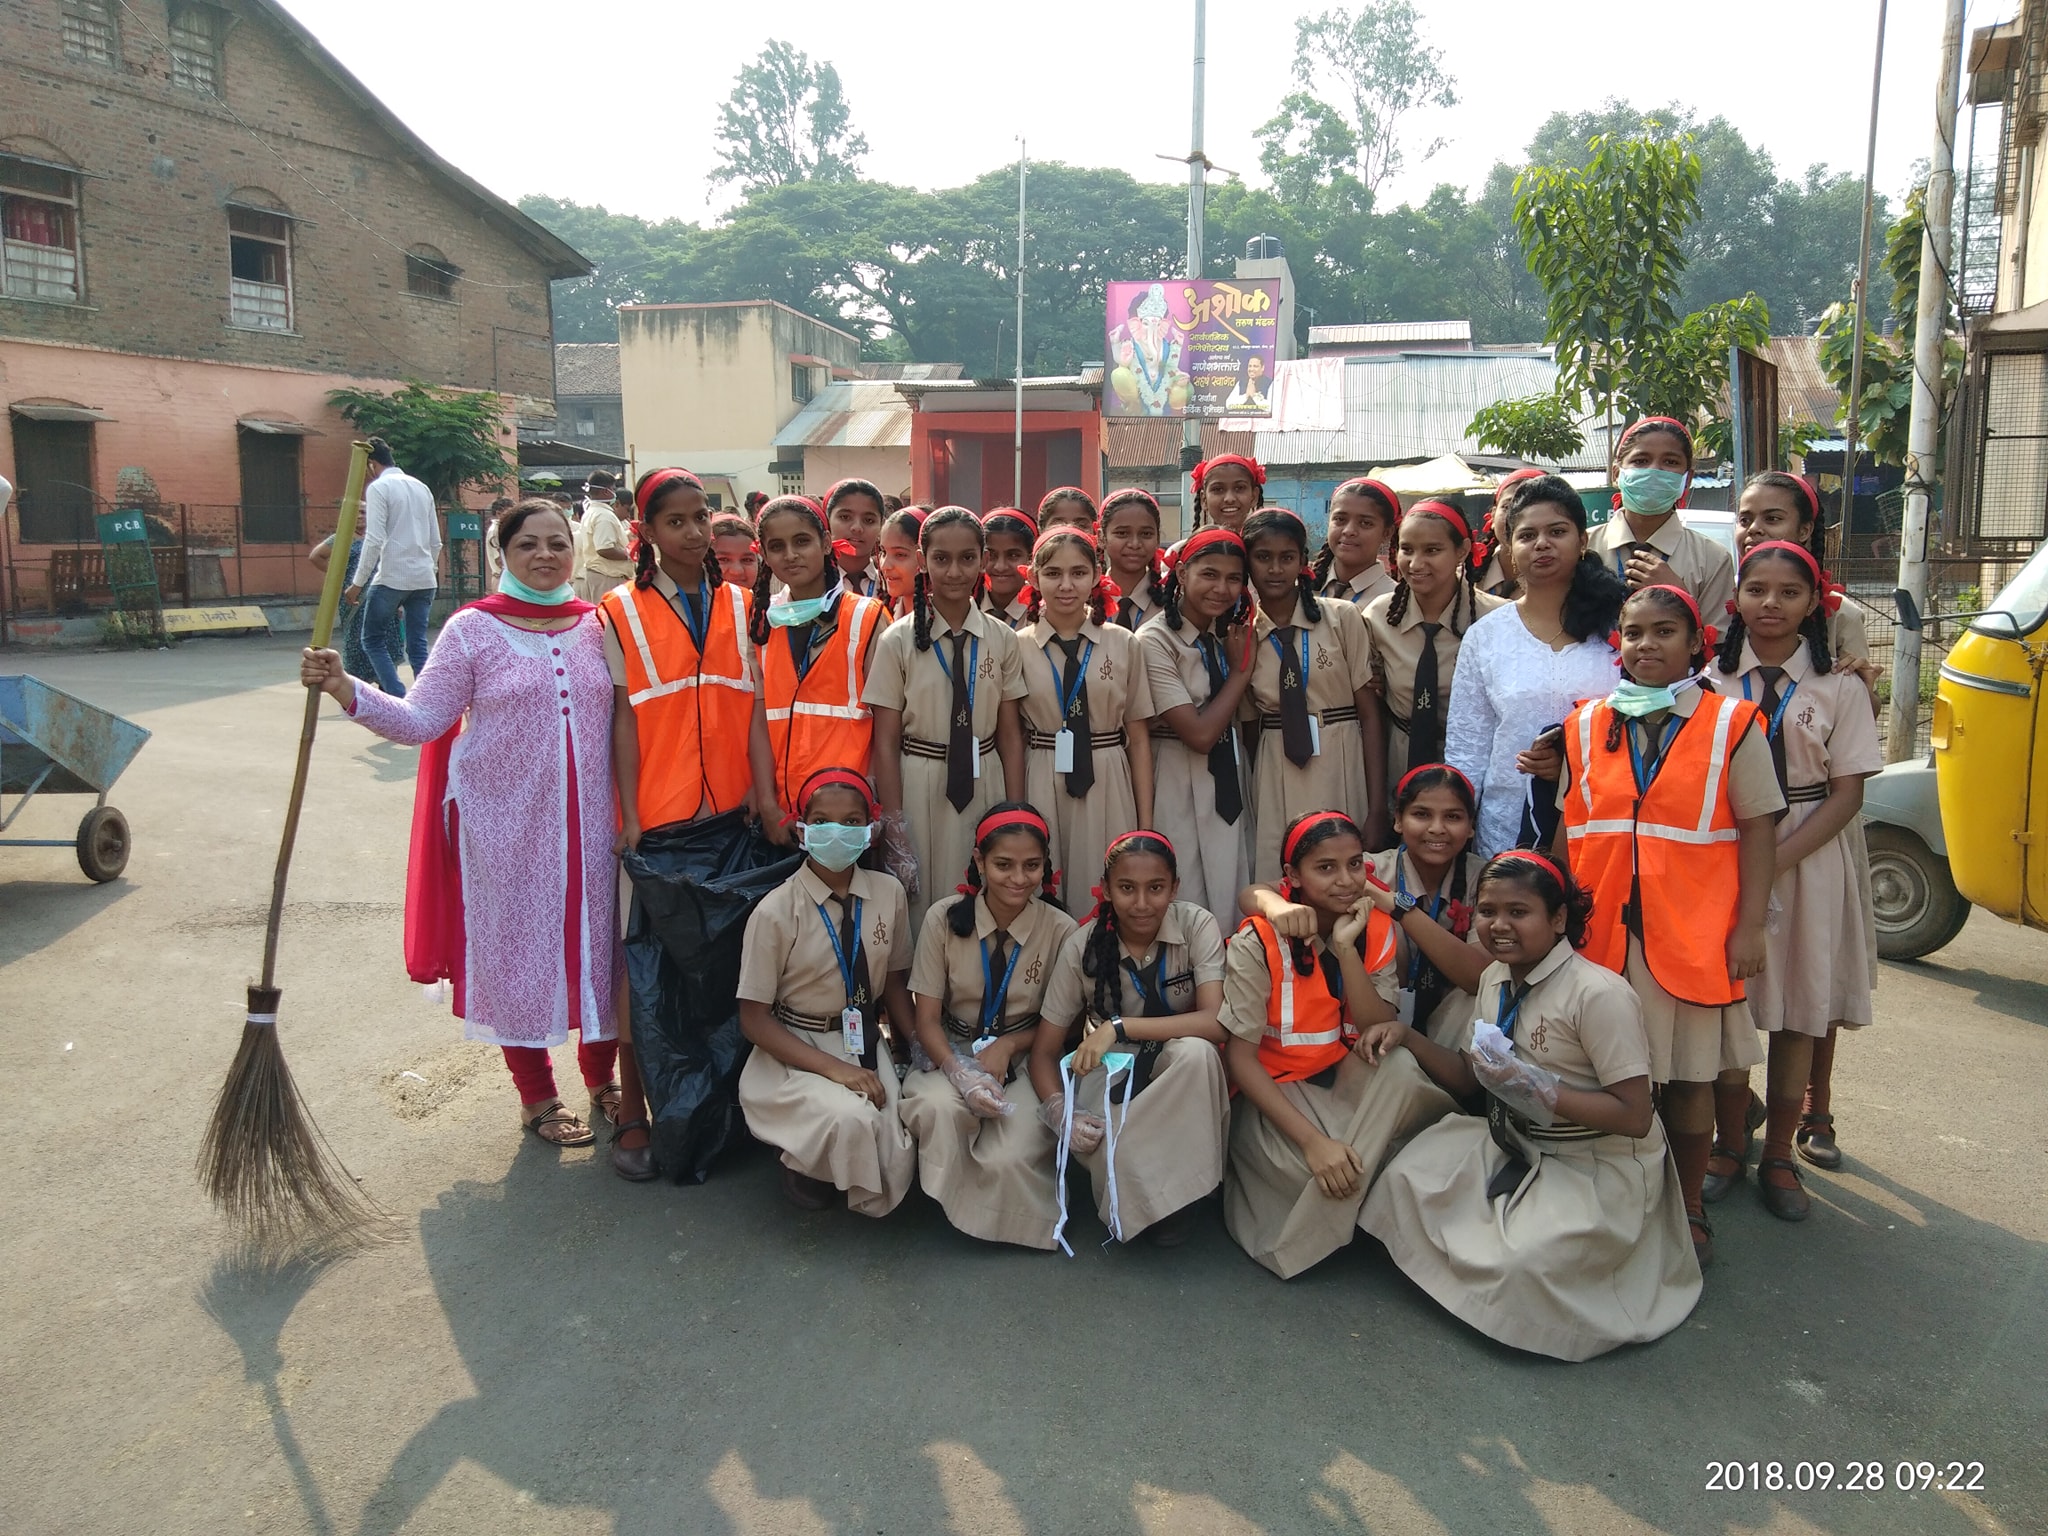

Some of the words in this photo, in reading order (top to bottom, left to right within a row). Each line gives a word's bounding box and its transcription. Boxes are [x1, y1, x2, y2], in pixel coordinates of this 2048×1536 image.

[1173, 282, 1270, 345] अशोक
[1235, 317, 1254, 327] तरुण
[1255, 315, 1276, 327] मंडळ
